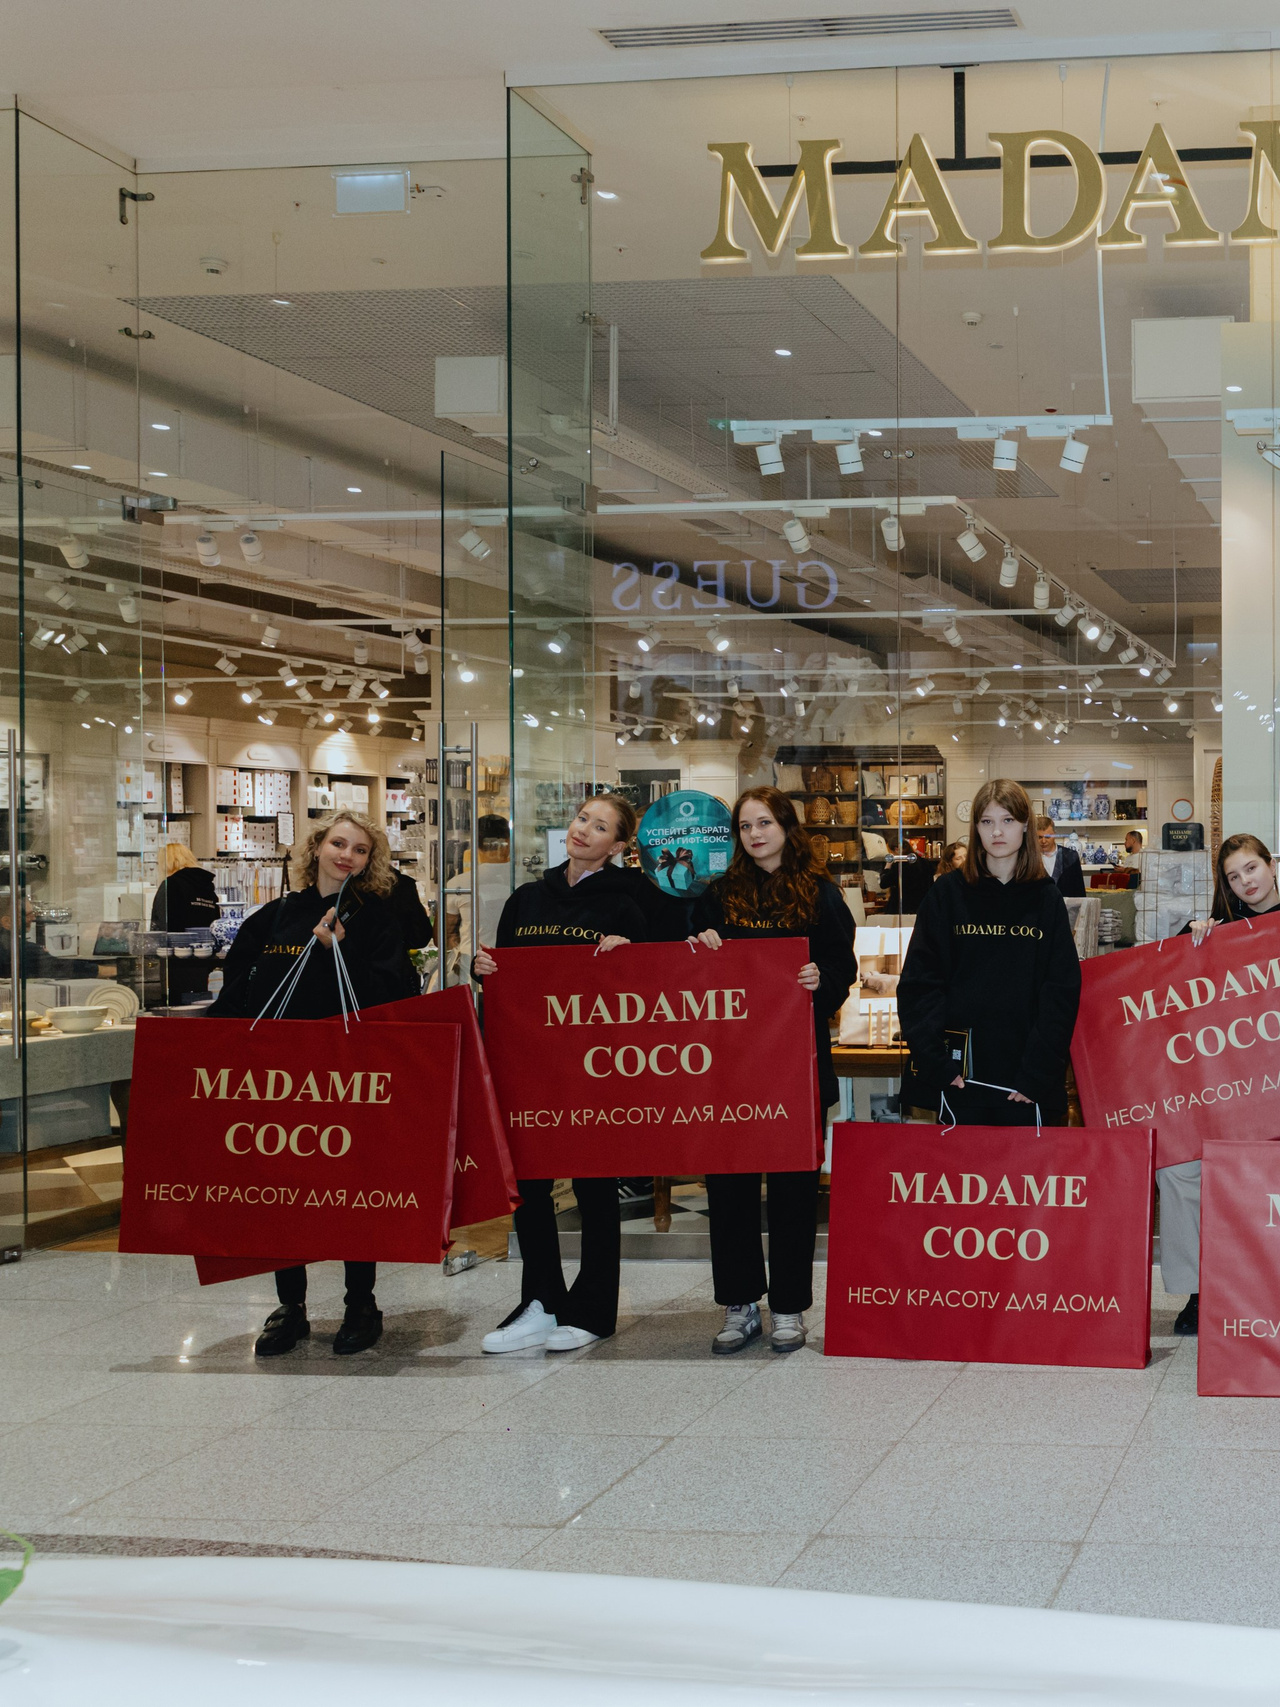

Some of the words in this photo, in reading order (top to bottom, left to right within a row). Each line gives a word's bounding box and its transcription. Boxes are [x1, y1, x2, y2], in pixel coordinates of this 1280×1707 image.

[646, 827, 687, 836] УСПЕЙТЕ
[690, 826, 730, 834] ЗАБРАТЬ
[648, 836, 675, 846] СВОЙ
[677, 835, 728, 844] ГИФТ-БОКС
[546, 989, 747, 1025] MADAME
[584, 1043, 712, 1077] COCO
[192, 1068, 392, 1103] MADAME
[1105, 1102, 1156, 1128] НЕСУ
[1163, 1077, 1253, 1114] КРАСОТУ
[511, 1110, 563, 1127] НЕСУ
[570, 1107, 665, 1125] КРАСОТУ
[673, 1105, 714, 1125] ДЛЯ
[721, 1103, 788, 1122] ДОМА
[225, 1123, 351, 1157] COCO
[145, 1184, 198, 1201] НЕСУ
[206, 1186, 298, 1204] КРАСОТУ
[304, 1189, 346, 1207] ДЛЯ
[352, 1190, 419, 1209] ДОМА
[889, 1172, 1087, 1207] MADAME
[923, 1226, 1049, 1261] COCO
[848, 1288, 900, 1305] НЕСУ
[907, 1290, 999, 1308] КРАСОТУ
[1005, 1293, 1047, 1311] ДЛЯ
[1053, 1294, 1121, 1313] ДОМА
